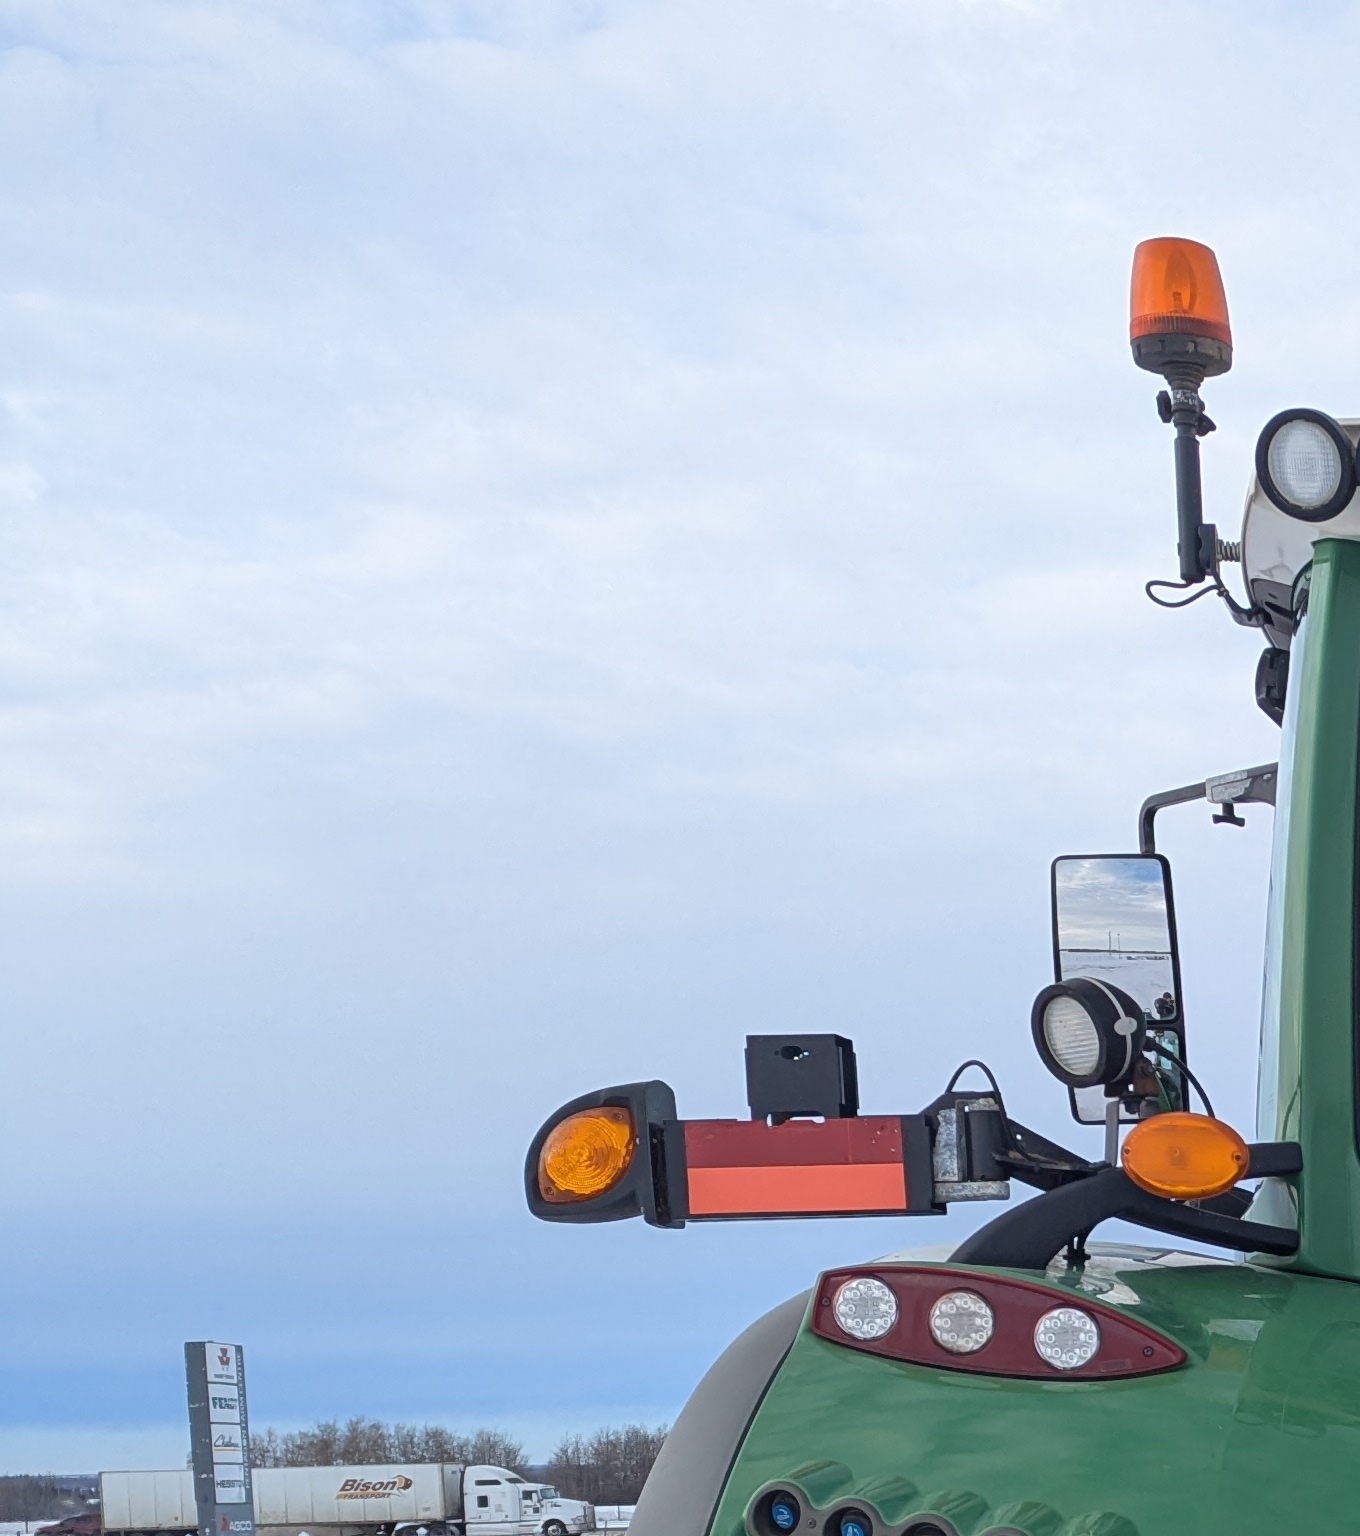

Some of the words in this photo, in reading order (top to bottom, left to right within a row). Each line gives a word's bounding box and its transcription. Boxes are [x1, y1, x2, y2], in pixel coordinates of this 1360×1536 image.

[339, 1479, 398, 1492] Bison
[342, 1492, 392, 1500] TRANSPORT
[229, 1520, 252, 1531] AGCO
